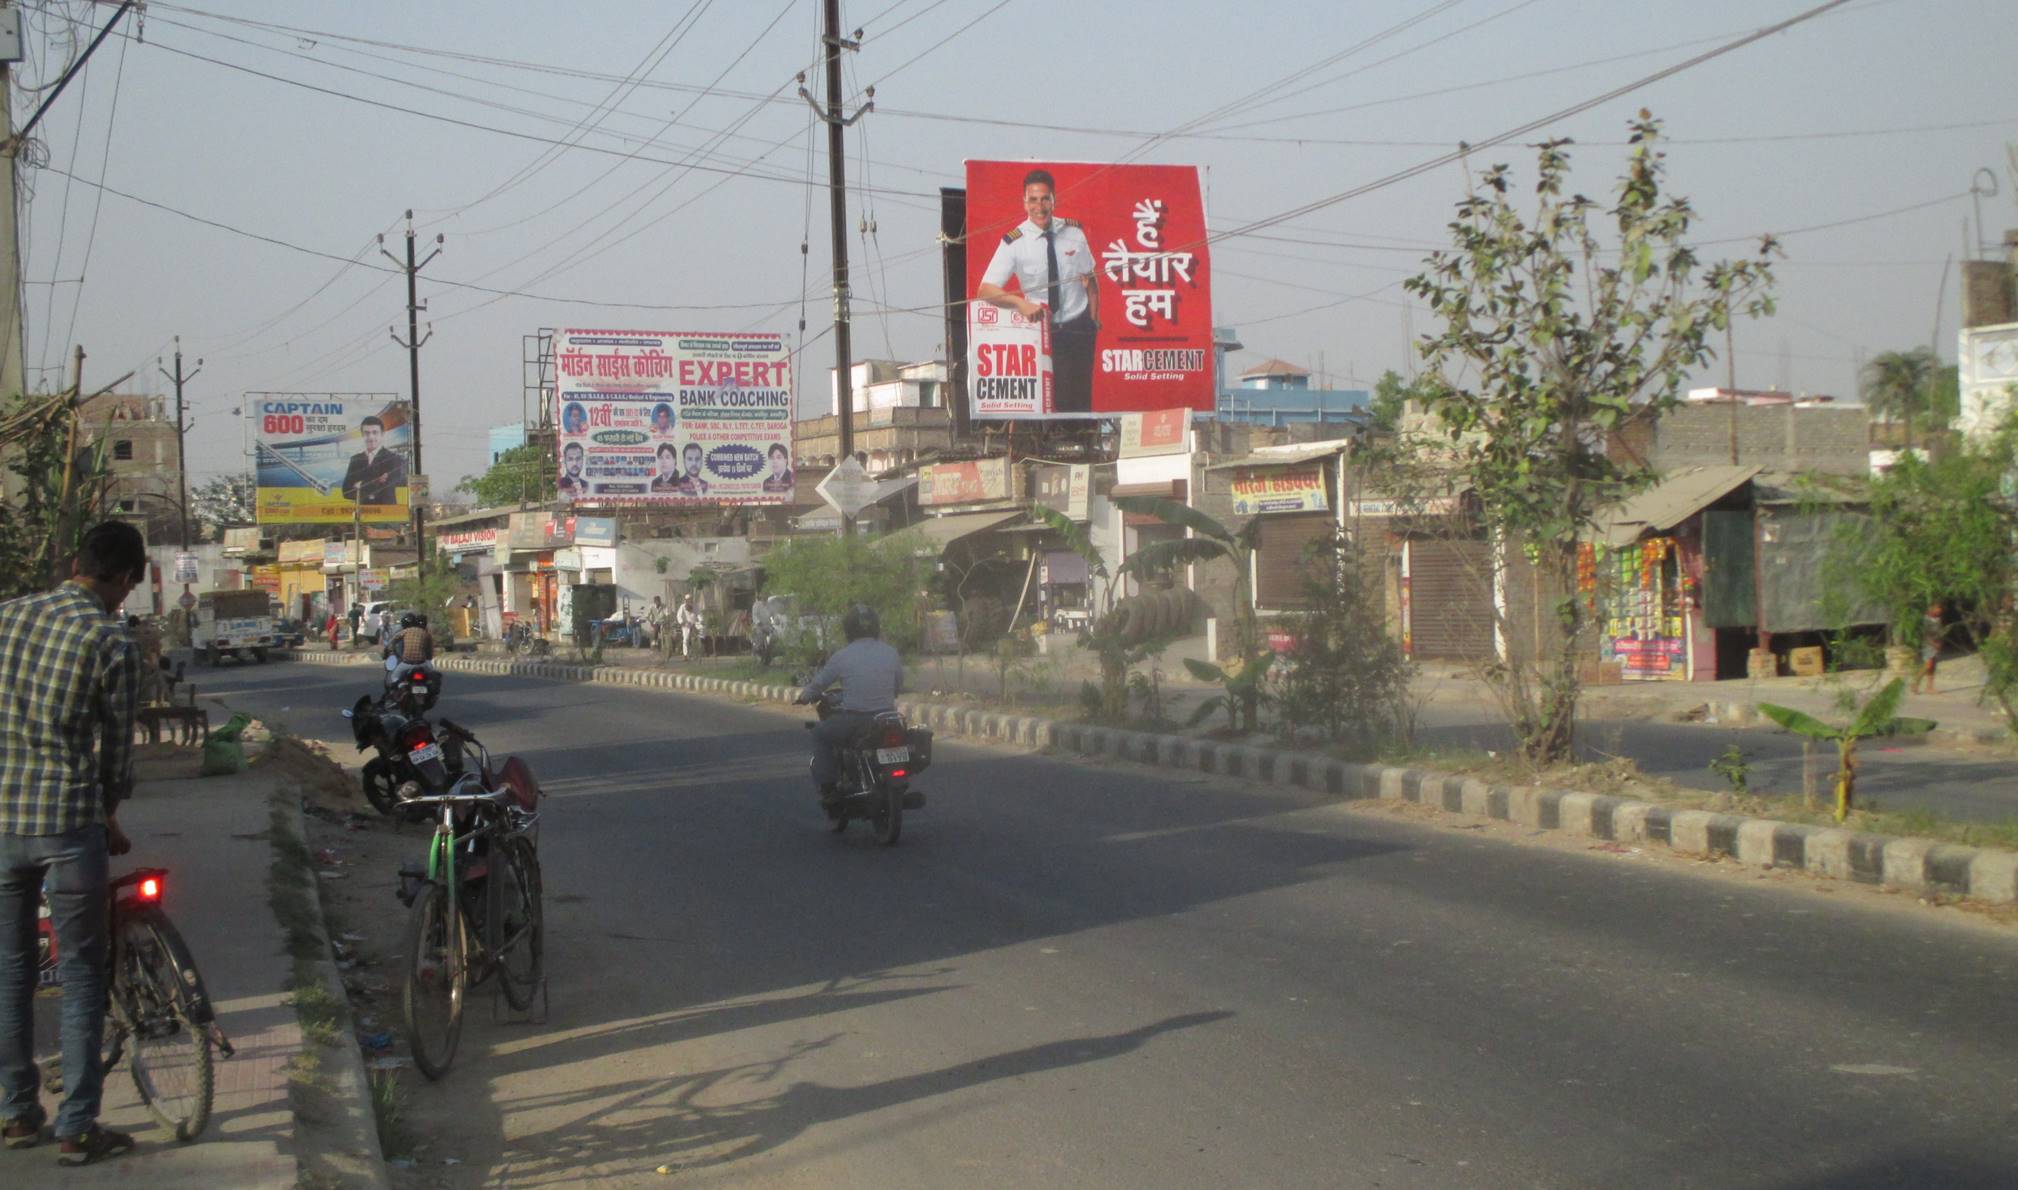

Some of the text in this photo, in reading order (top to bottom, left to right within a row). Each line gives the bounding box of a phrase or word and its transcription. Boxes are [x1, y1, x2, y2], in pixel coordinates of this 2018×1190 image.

[1102, 239, 1191, 282] तैयार
[1122, 290, 1175, 325] हम
[977, 344, 1037, 377] STAR
[679, 360, 788, 387] EXPERT
[1151, 373, 1184, 381] Setting
[680, 389, 789, 407] BANK COACHING
[976, 378, 1037, 400] CEMENT
[264, 403, 343, 415] CAPTAIN
[1004, 402, 1033, 411] Setting
[264, 415, 304, 433] 600
